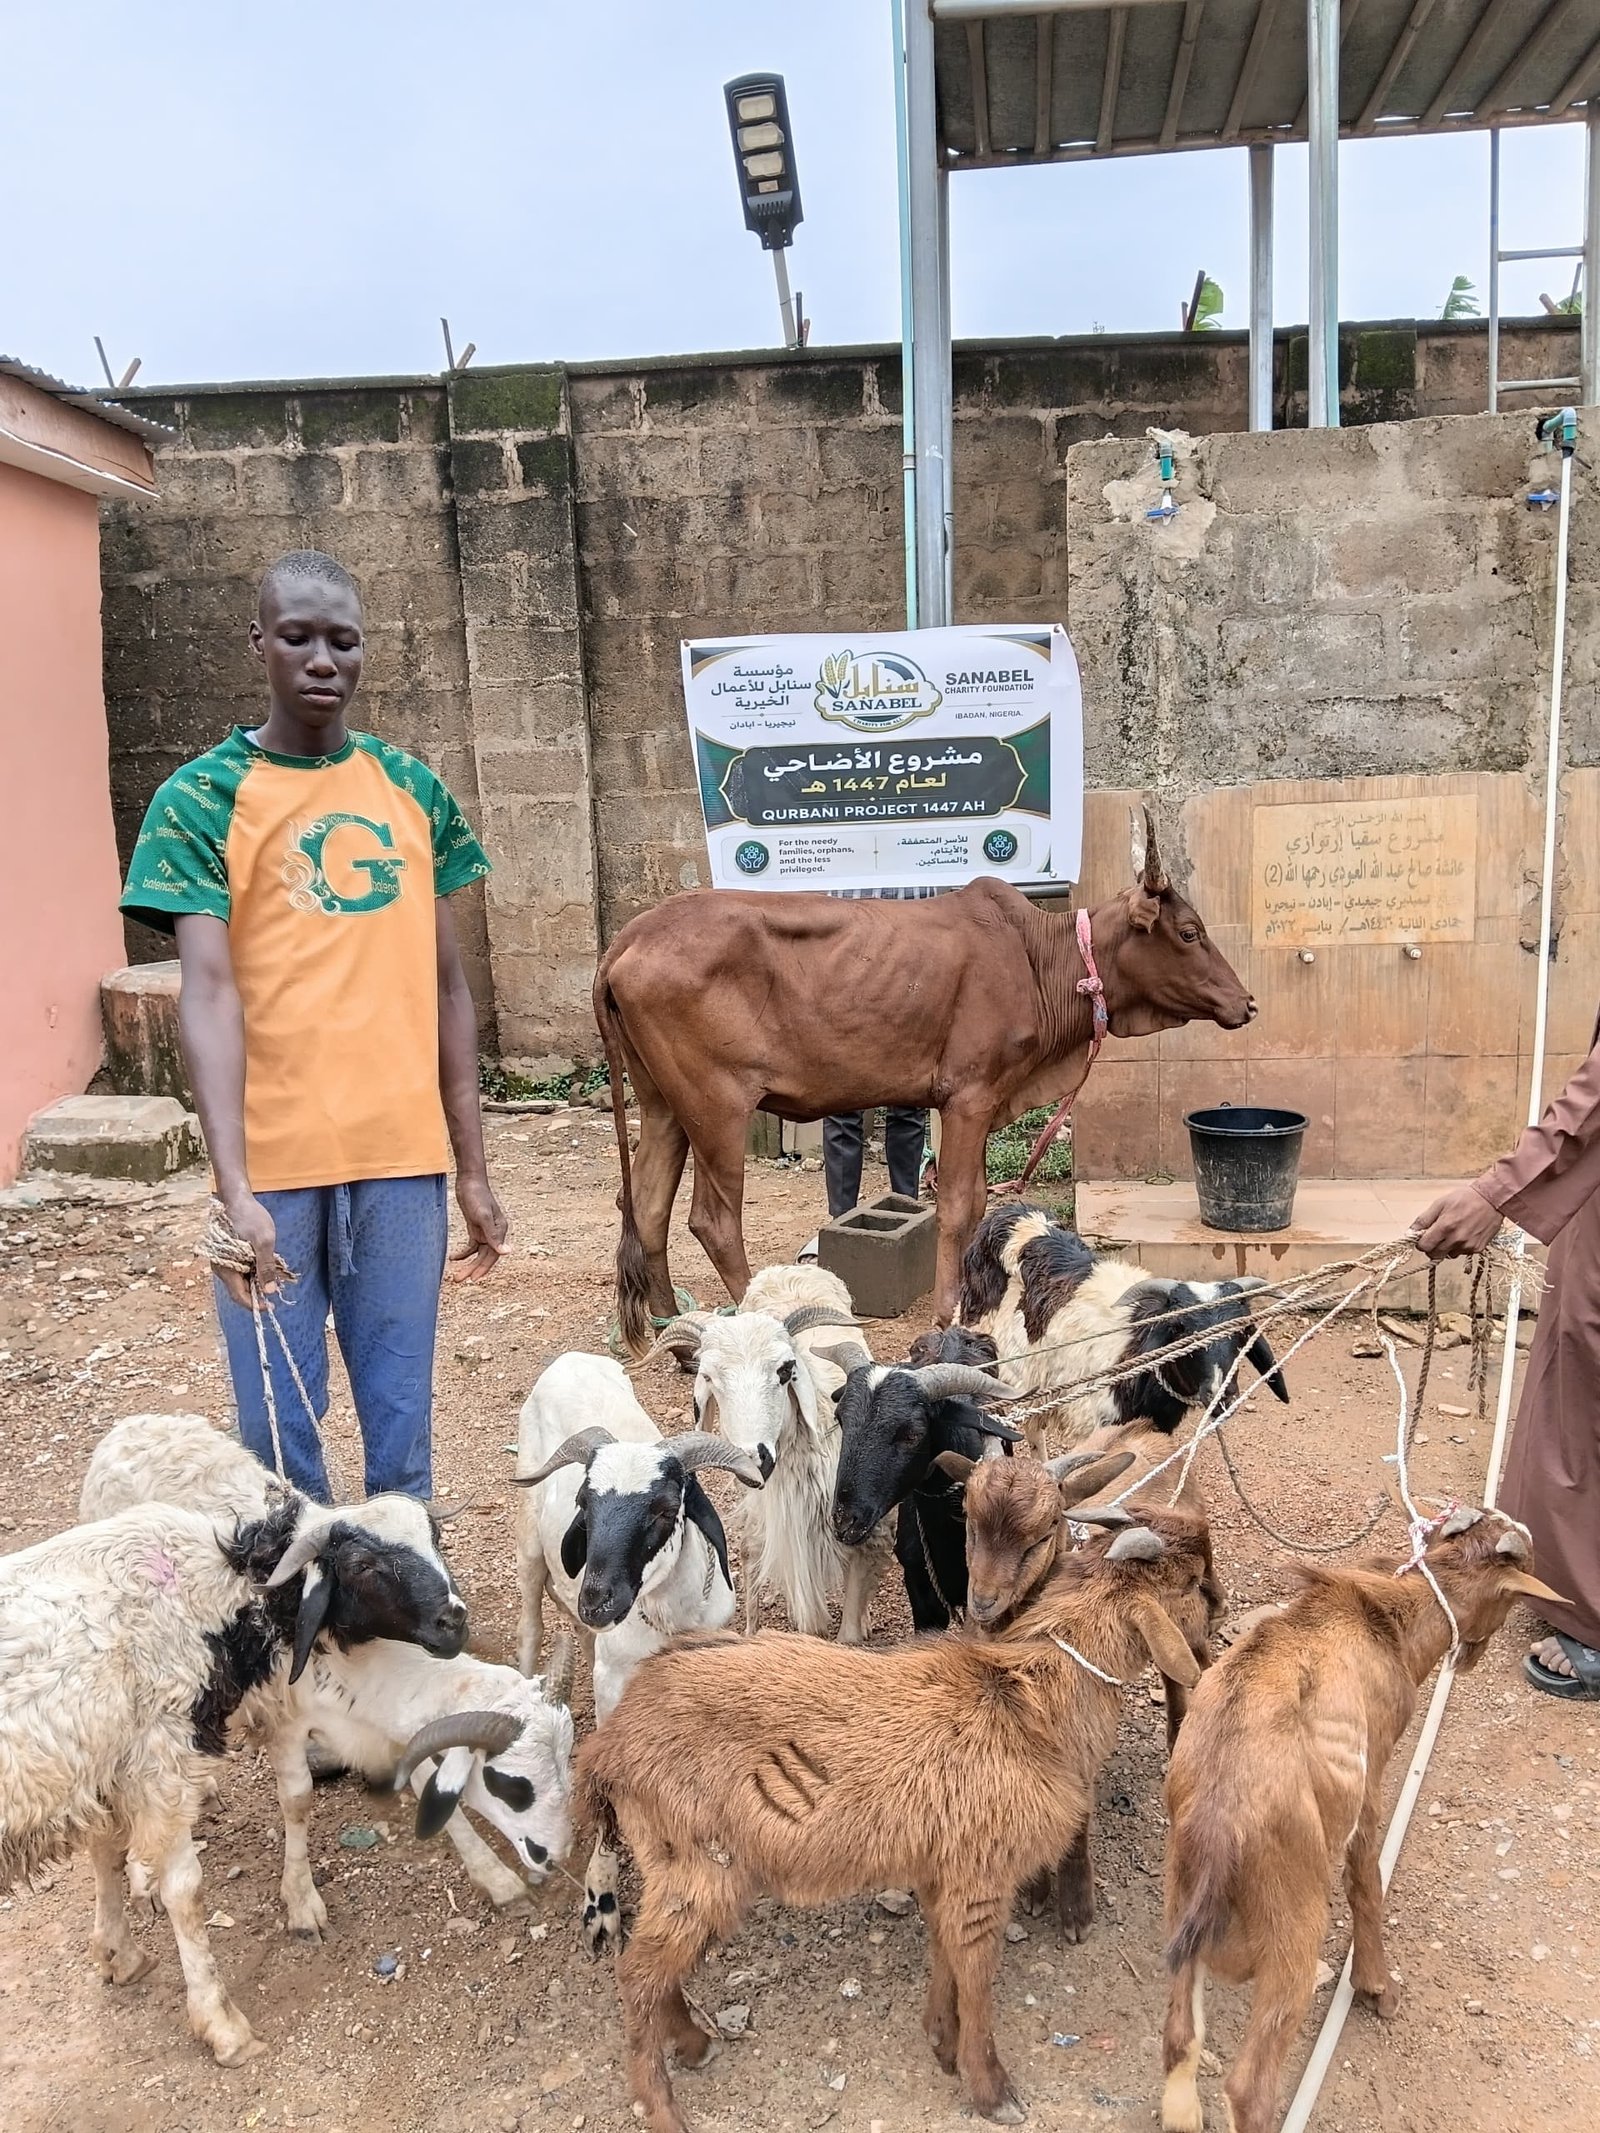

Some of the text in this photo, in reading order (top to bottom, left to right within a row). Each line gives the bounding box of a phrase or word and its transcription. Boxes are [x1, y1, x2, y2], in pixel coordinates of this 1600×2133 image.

[733, 664, 793, 678] مؤسسة
[946, 669, 1034, 685] SANABEL
[711, 680, 811, 696] سنابل للأعمال
[843, 662, 919, 699] سنابل
[944, 683, 1033, 694] CHARITY FOUNDATION
[735, 695, 789, 710] الخيرية
[832, 697, 922, 711] SANABEL
[955, 711, 987, 720] IBADAN,
[765, 720, 796, 729] نيجيريا
[763, 746, 983, 782] مشروع الأضاحي
[833, 776, 889, 792] 1447
[896, 772, 946, 794] لعام
[762, 800, 985, 820] QURBANI PROJECT 1447 AH
[779, 837, 838, 847] For the needy
[944, 834, 968, 845] للأسر
[1350, 829, 1381, 851] سقيا
[1388, 829, 1444, 854] مشروع
[779, 846, 855, 856] families, orphans,
[798, 856, 813, 864] the
[1285, 855, 1298, 881] الله
[1370, 852, 1382, 879] الله
[1436, 858, 1465, 877] عائشة
[780, 865, 826, 875] privileged.
[1264, 862, 1283, 888] (2)
[1386, 862, 1404, 882] عبد
[1407, 857, 1433, 889] صالح
